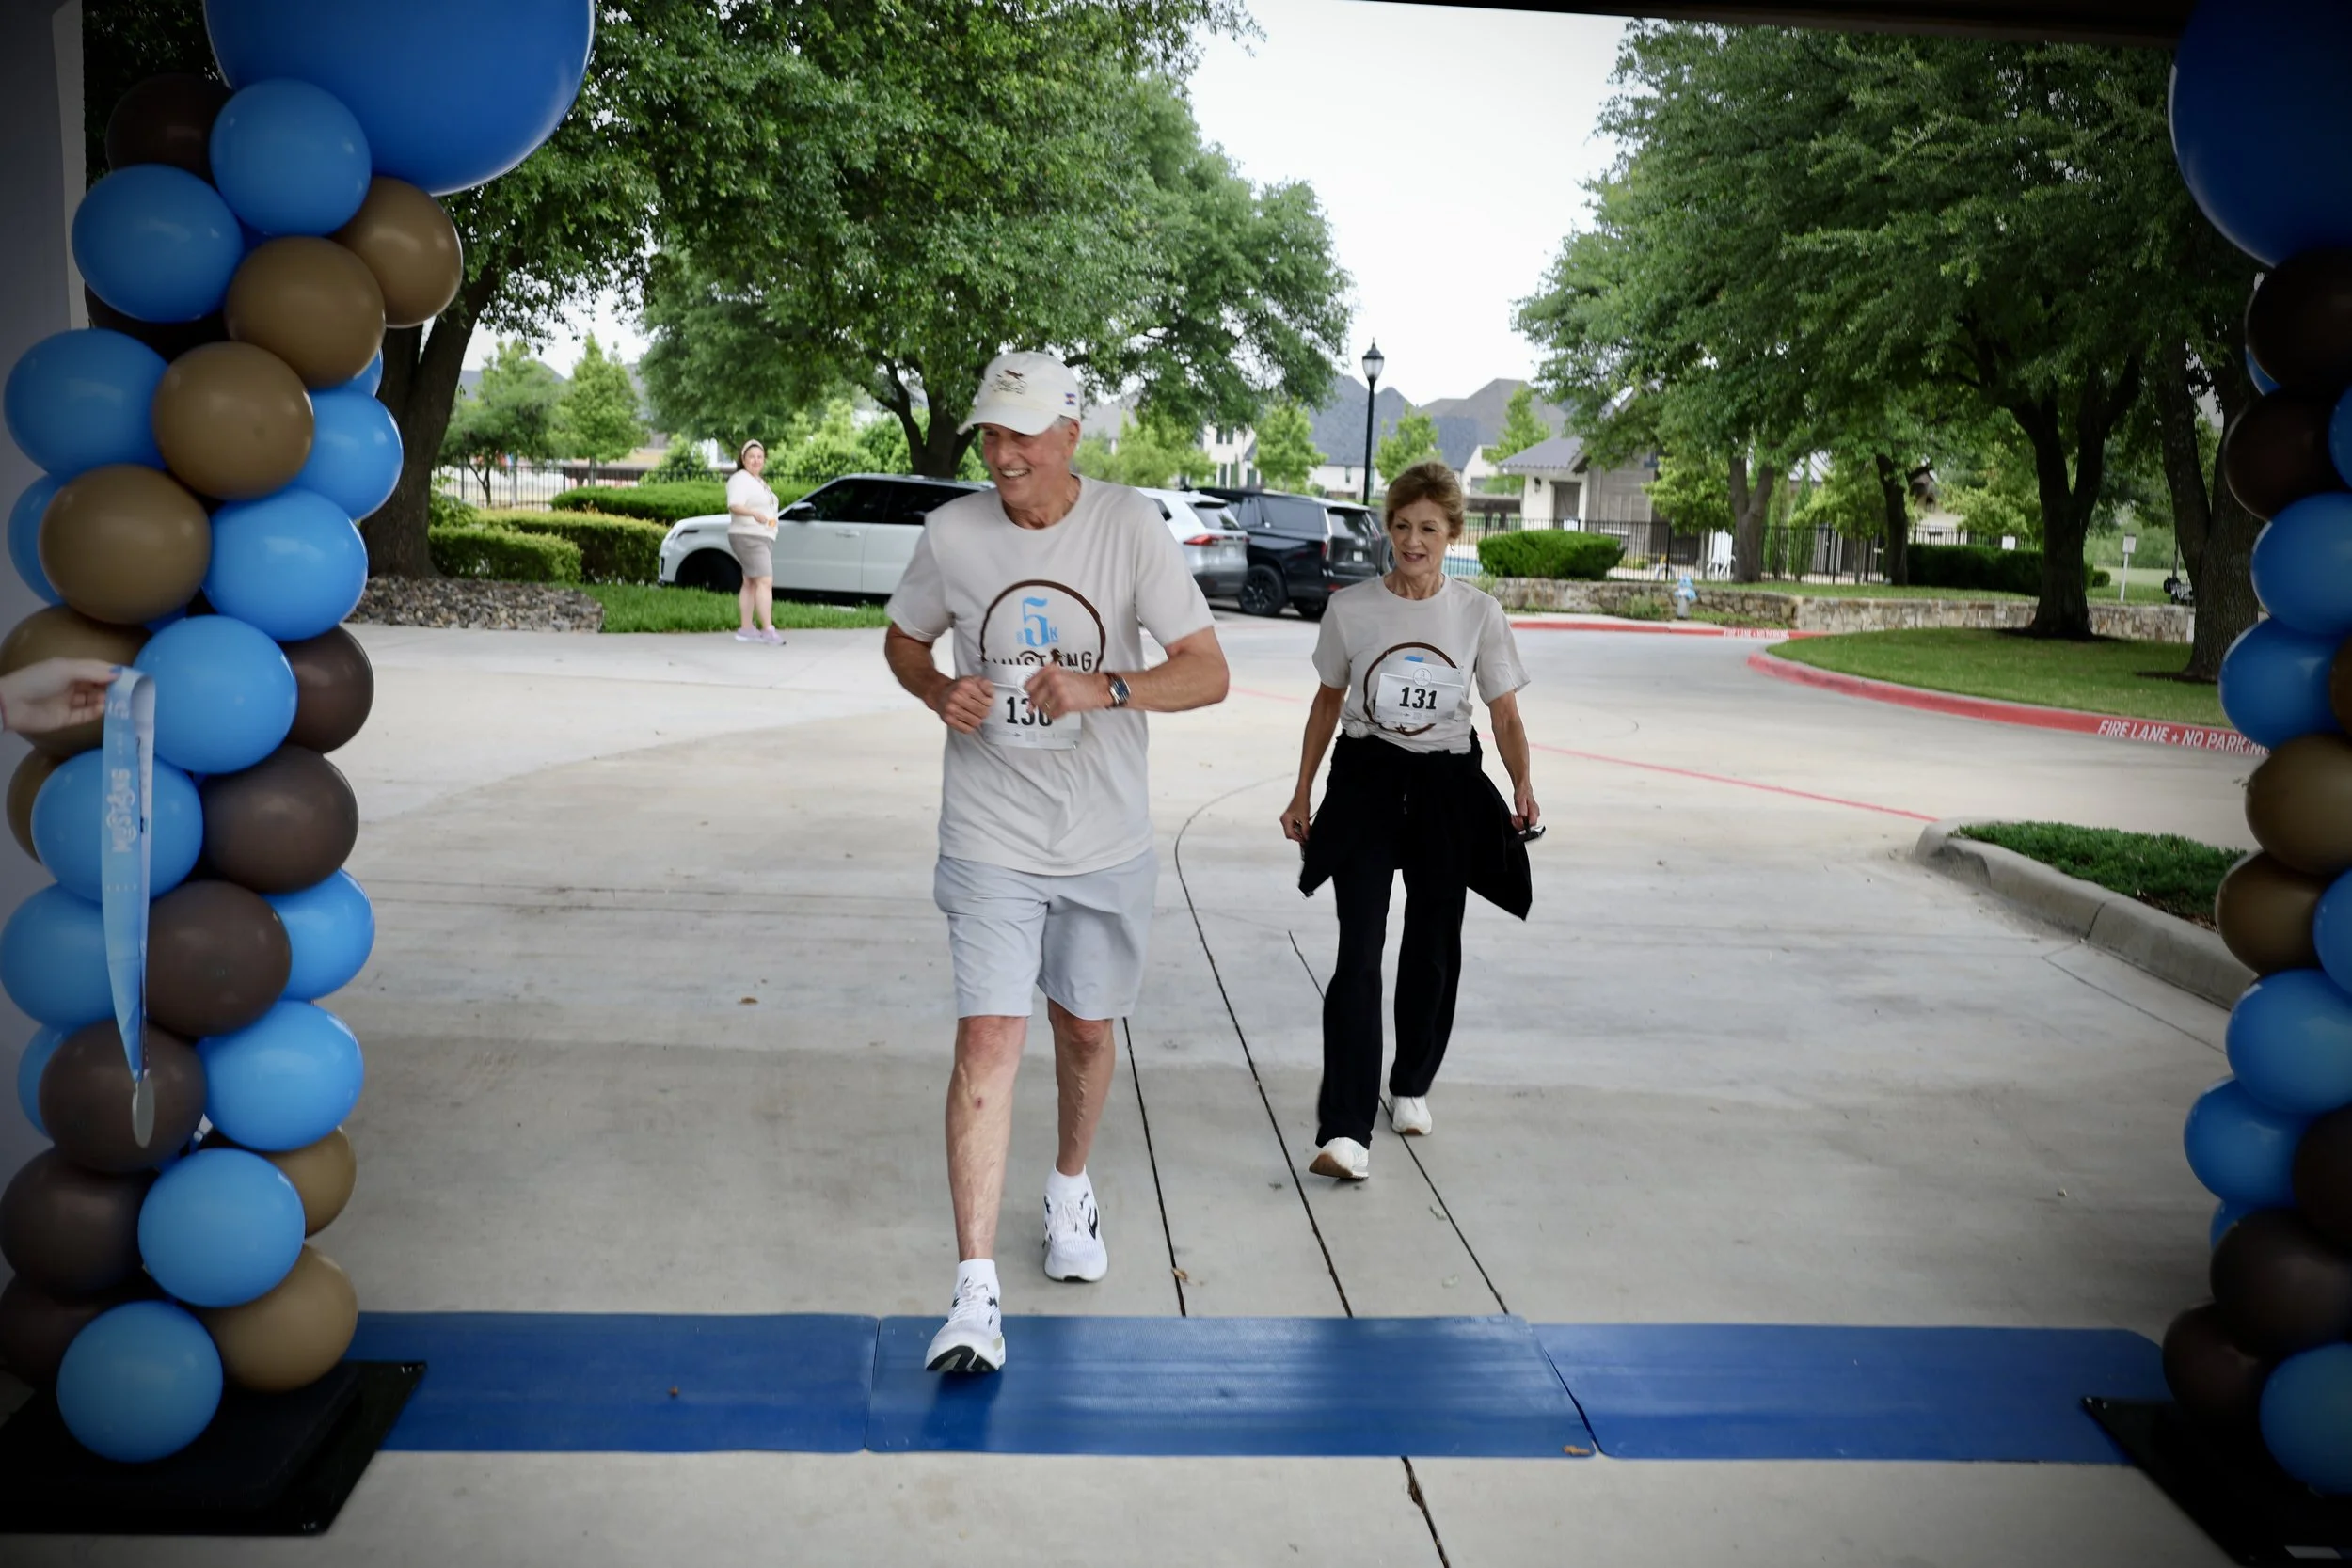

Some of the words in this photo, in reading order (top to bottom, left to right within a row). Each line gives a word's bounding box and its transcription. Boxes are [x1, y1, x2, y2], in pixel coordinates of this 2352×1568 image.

[1399, 686, 1438, 710] 131
[2097, 720, 2130, 738] FIRE
[2130, 722, 2170, 743] LANE
[2182, 729, 2204, 747] NO
